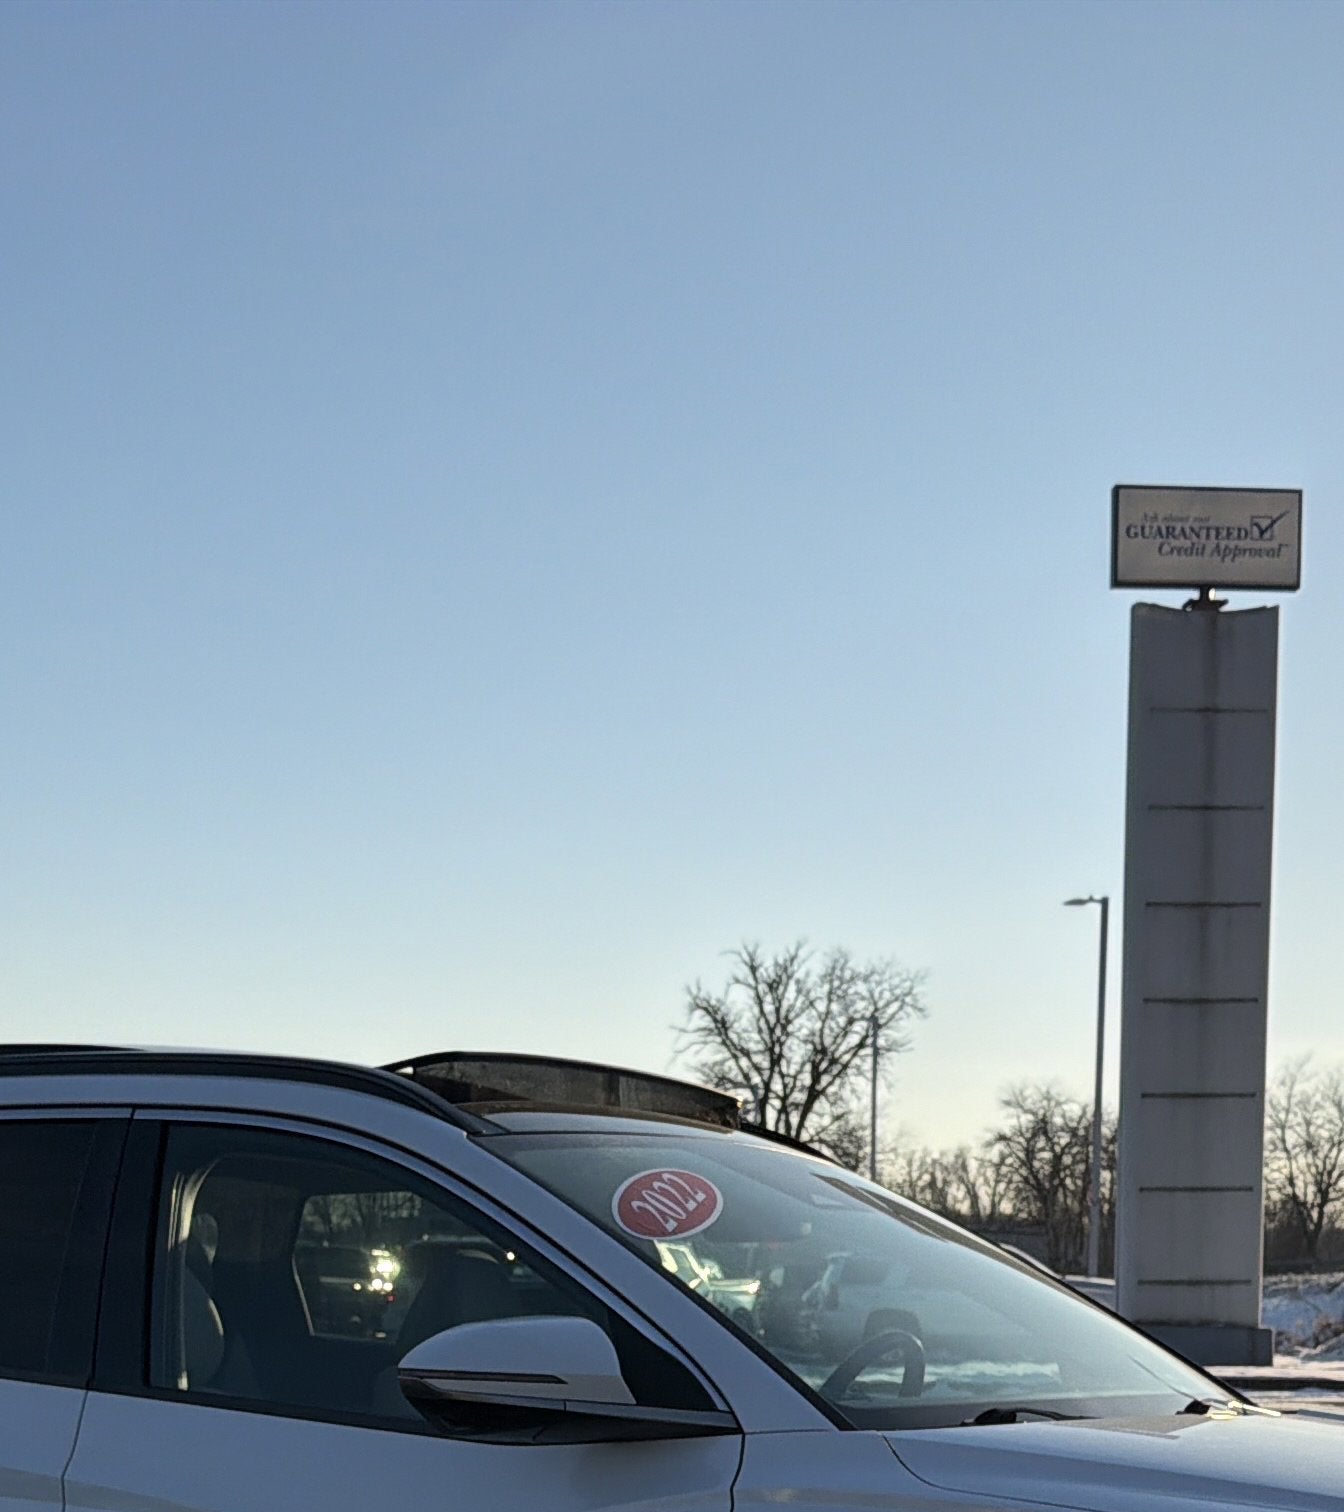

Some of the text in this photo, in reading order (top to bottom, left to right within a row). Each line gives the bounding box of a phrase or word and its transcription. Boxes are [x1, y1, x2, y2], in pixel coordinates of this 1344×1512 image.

[1125, 524, 1249, 541] GUARANTEED
[1158, 541, 1284, 563] Credit Approval
[630, 1172, 707, 1233] 2022
